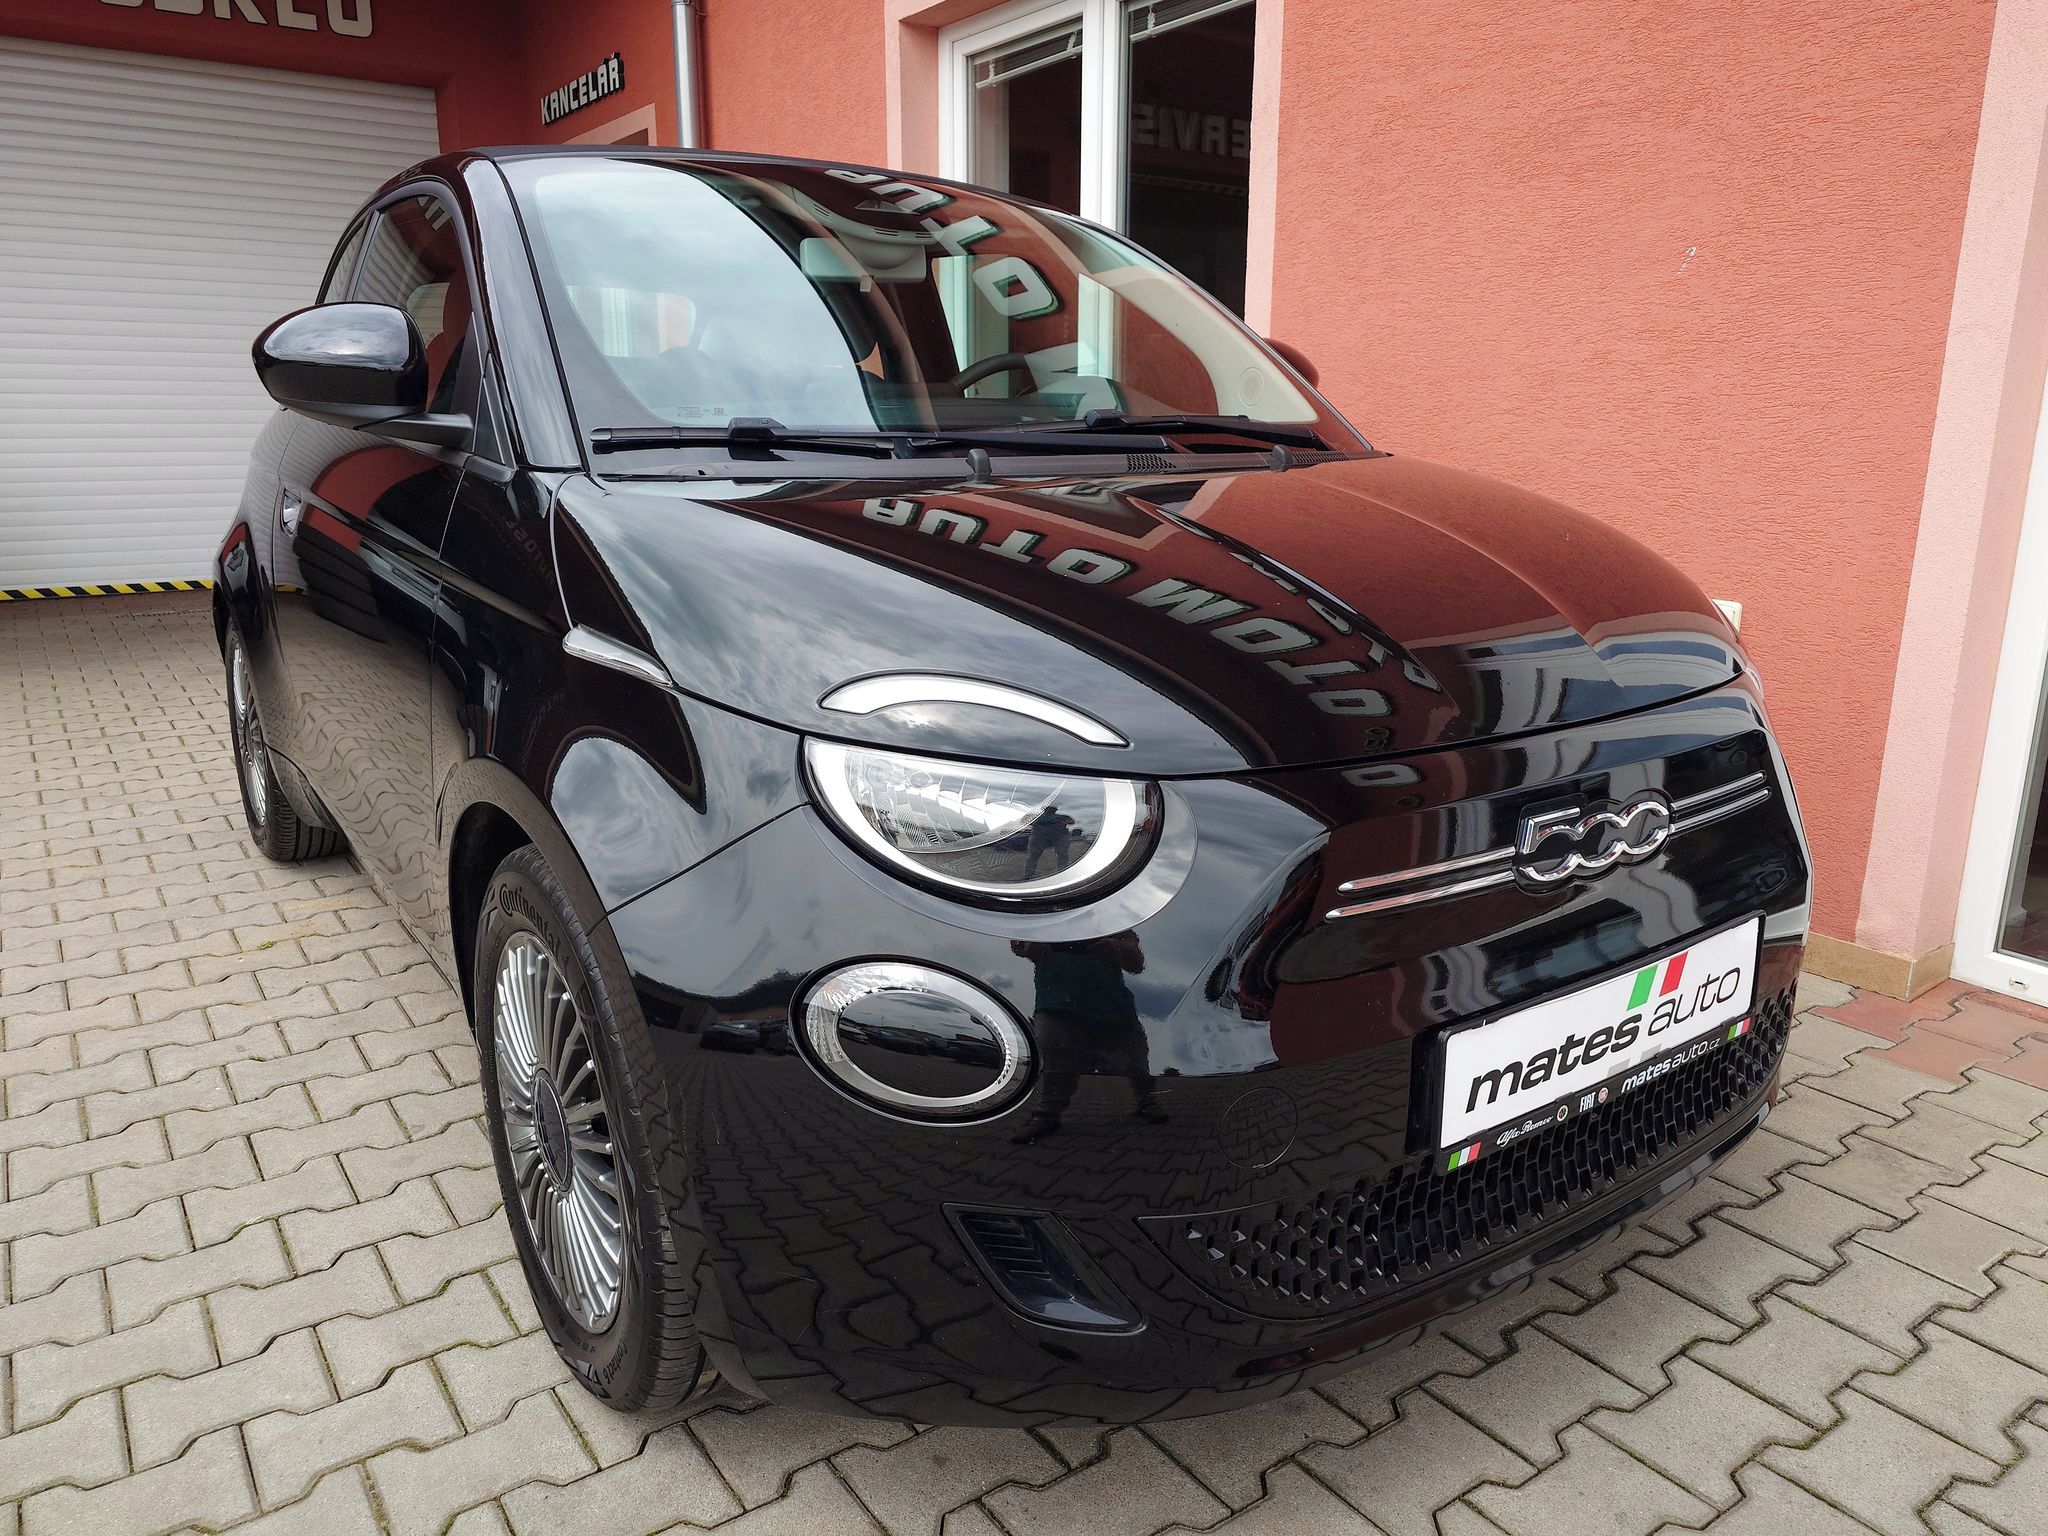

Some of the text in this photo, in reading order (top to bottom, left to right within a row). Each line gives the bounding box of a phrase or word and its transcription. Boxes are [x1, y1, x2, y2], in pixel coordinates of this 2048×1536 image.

[541, 52, 622, 125] KANCELÁŘ
[1518, 801, 1669, 882] 500
[499, 883, 562, 960] Continental
[1465, 967, 1740, 1113] mates auto
[1580, 1091, 1596, 1113] FIAT
